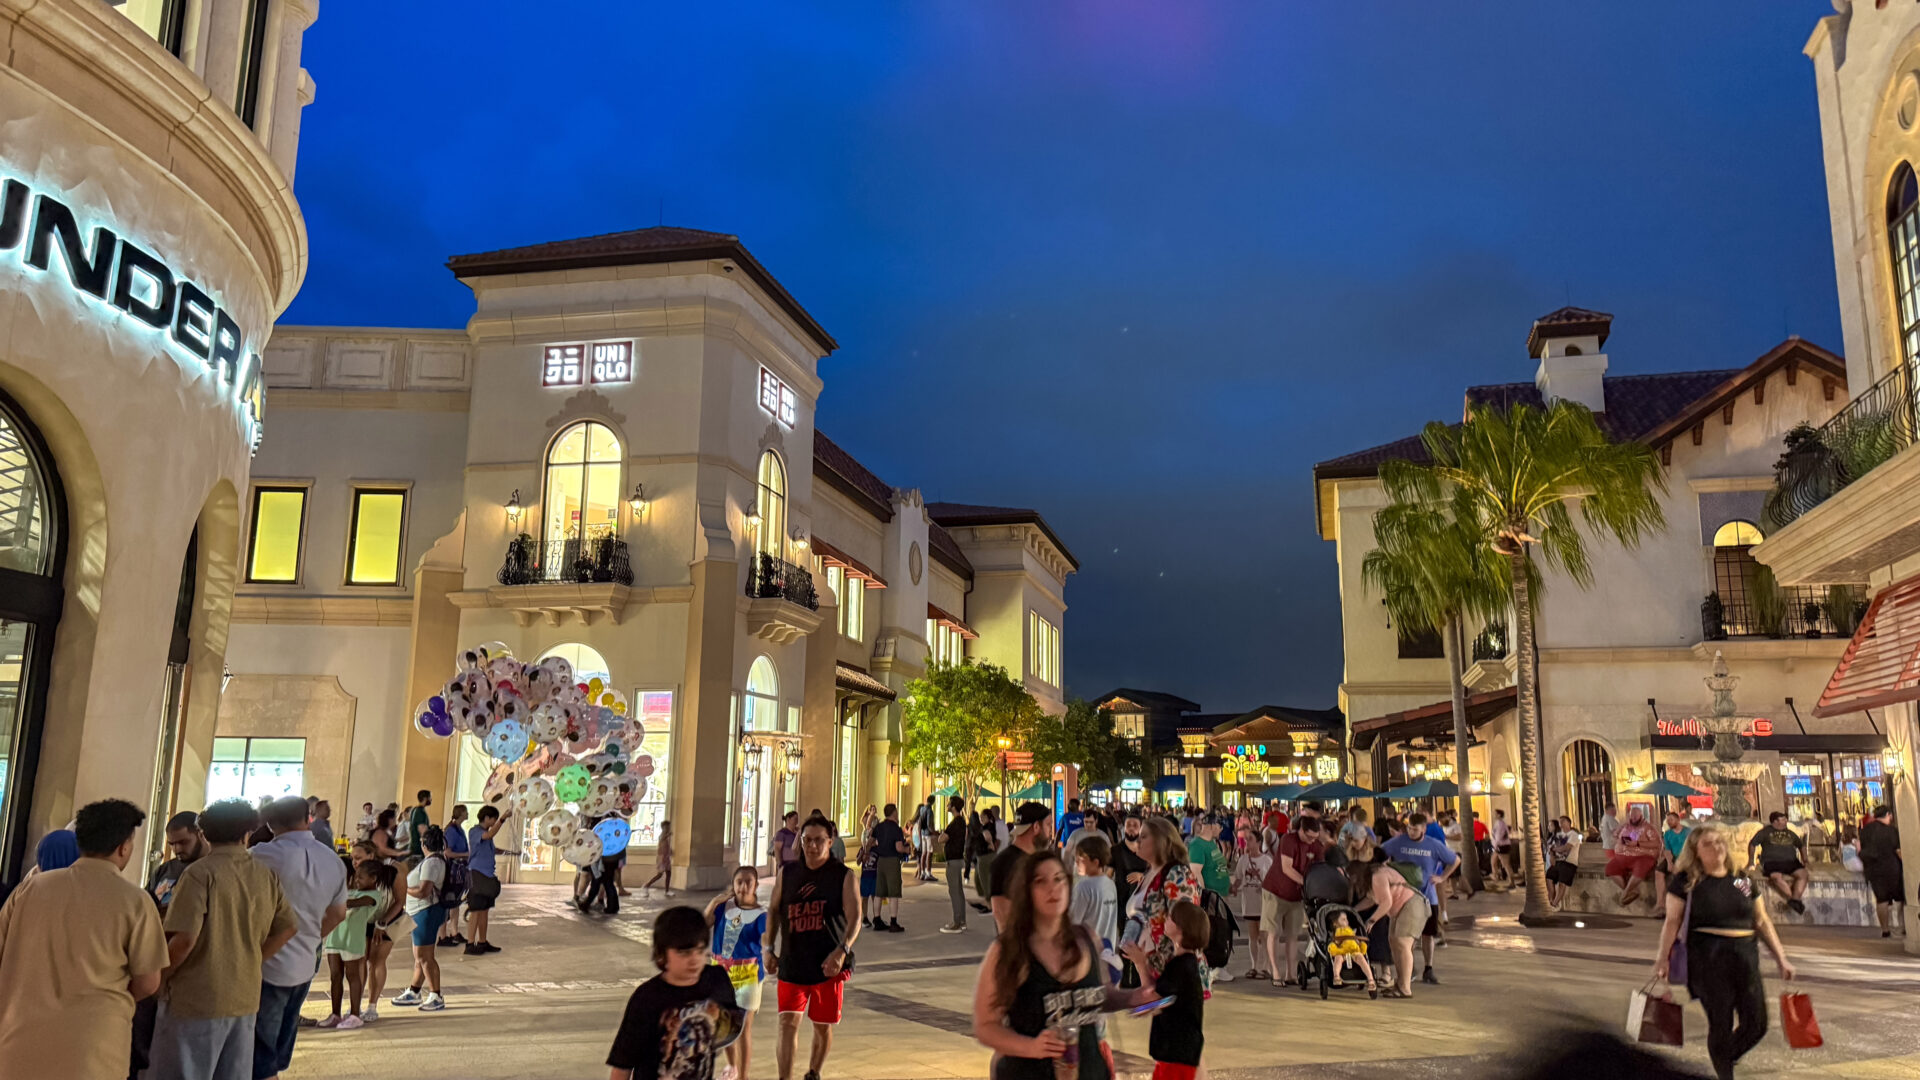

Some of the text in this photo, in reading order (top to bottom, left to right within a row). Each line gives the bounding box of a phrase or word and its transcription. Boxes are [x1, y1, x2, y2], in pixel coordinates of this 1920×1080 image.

[595, 344, 625, 362] UNI
[594, 362, 627, 381] QLO
[1228, 744, 1266, 756] WORLD
[788, 901, 827, 919] BEAST
[790, 916, 824, 933] MODE
